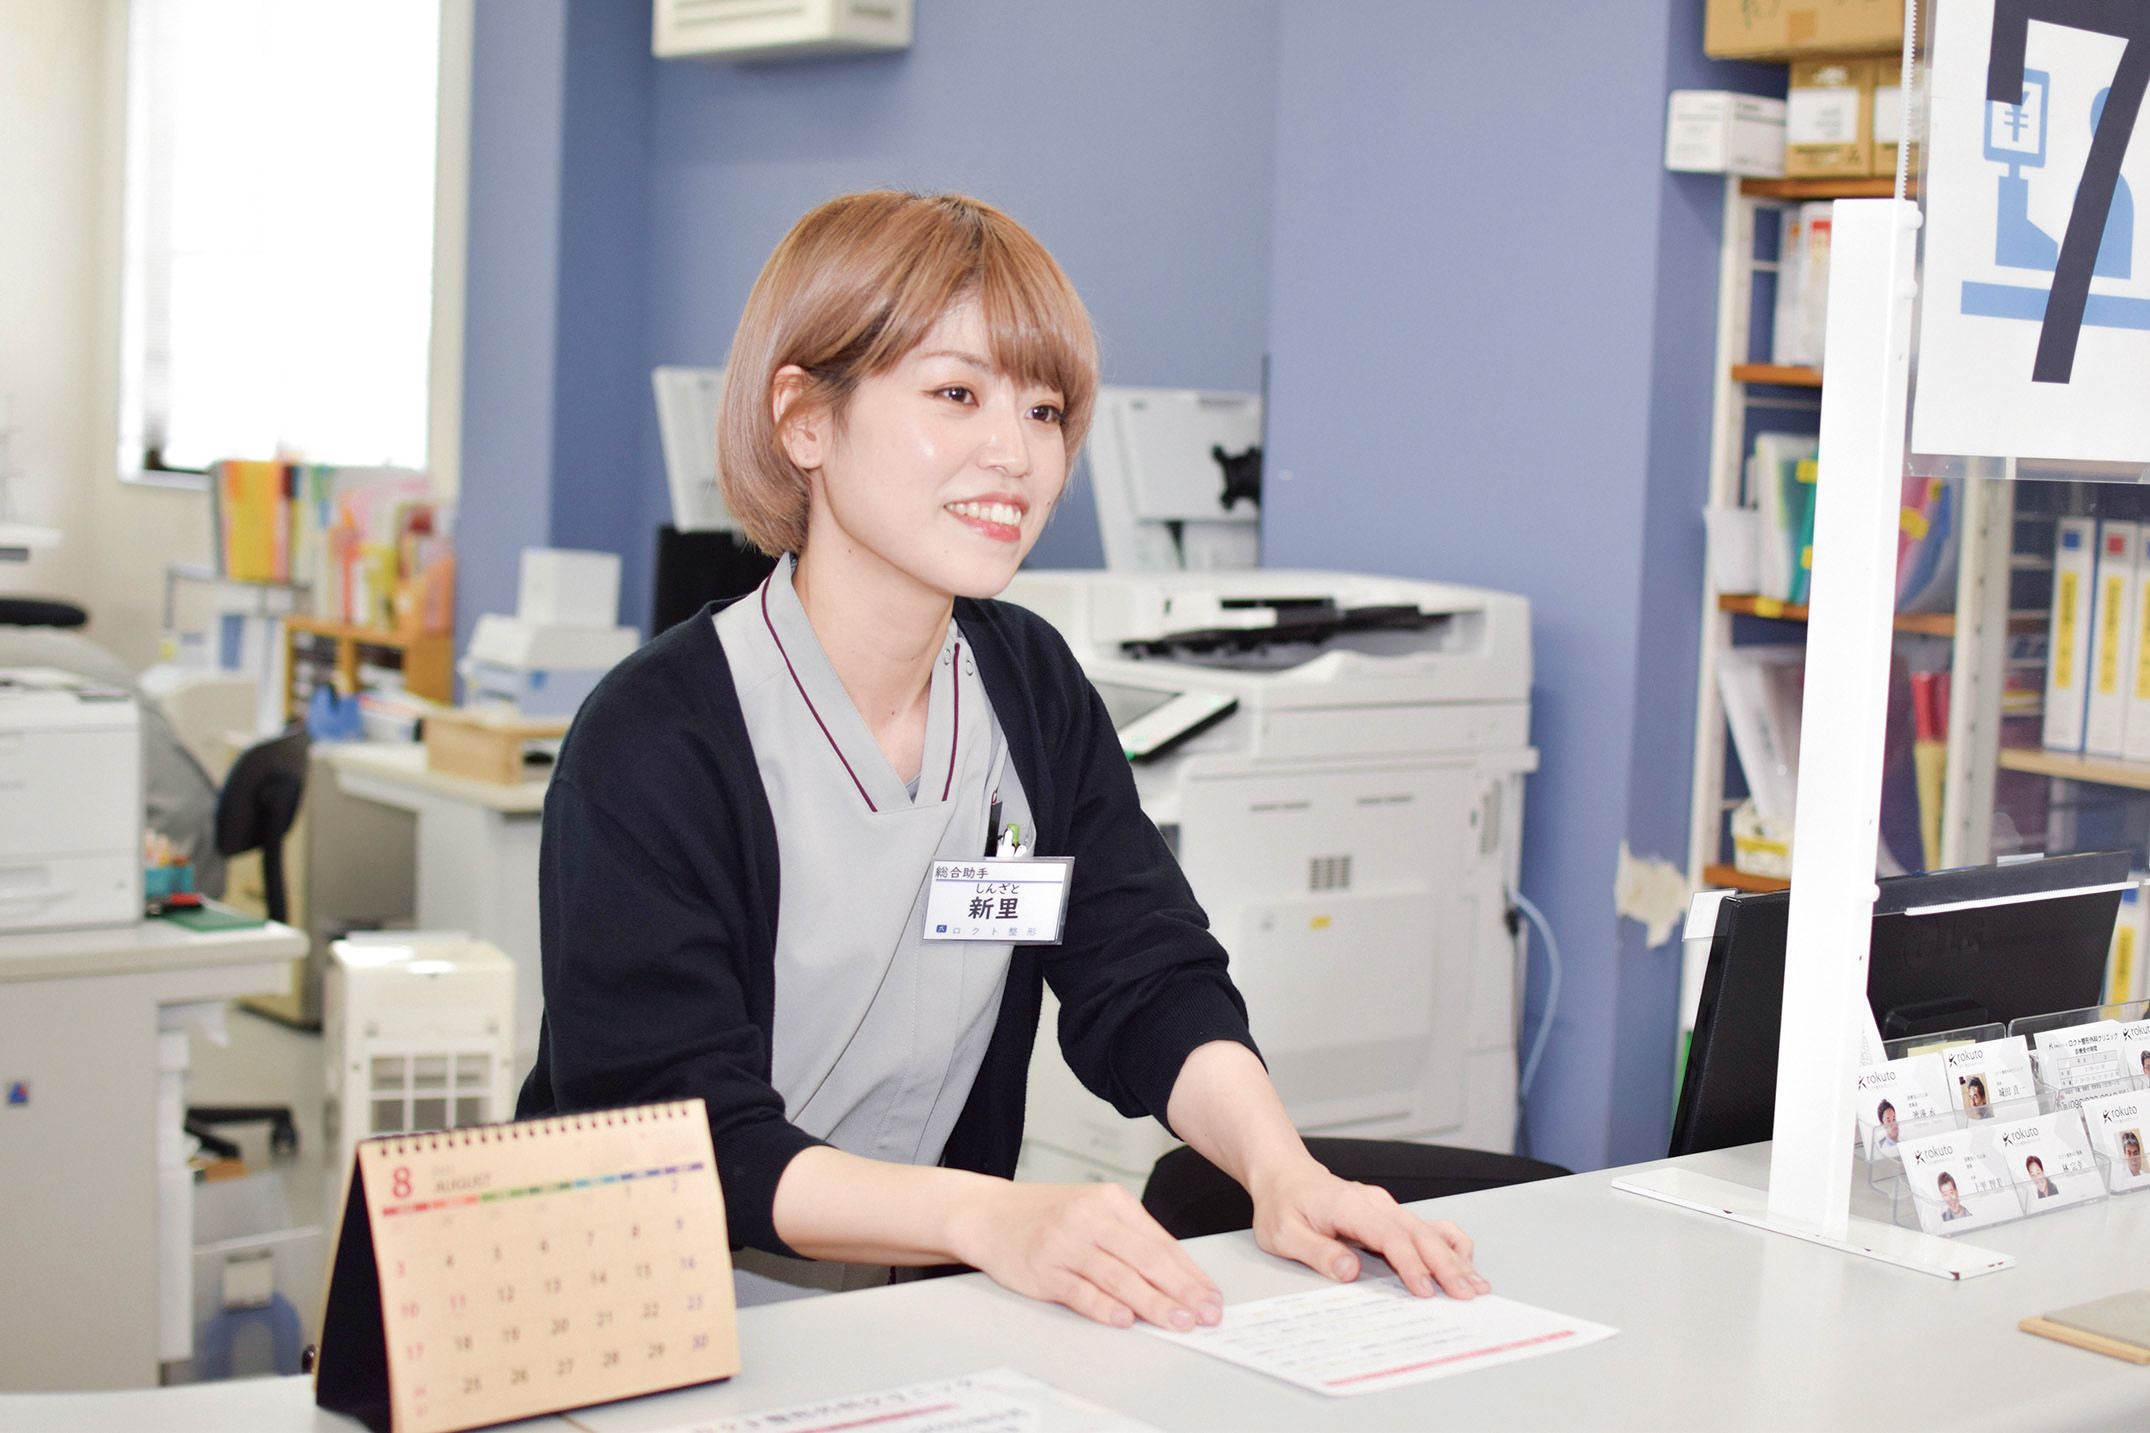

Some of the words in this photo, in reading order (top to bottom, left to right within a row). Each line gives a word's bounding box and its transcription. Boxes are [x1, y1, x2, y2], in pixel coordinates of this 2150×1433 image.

[935, 866, 989, 879] 総合助手
[976, 883, 1021, 895] しんざと
[968, 896, 1019, 920] 新里
[1956, 1050, 1984, 1063] rokuto
[1866, 1071, 1896, 1085] rokuto
[2110, 1105, 2138, 1118] rokuto
[2011, 1126, 2039, 1142] rokuto
[1924, 1144, 1954, 1160] rokuto
[392, 1166, 412, 1199] 8
